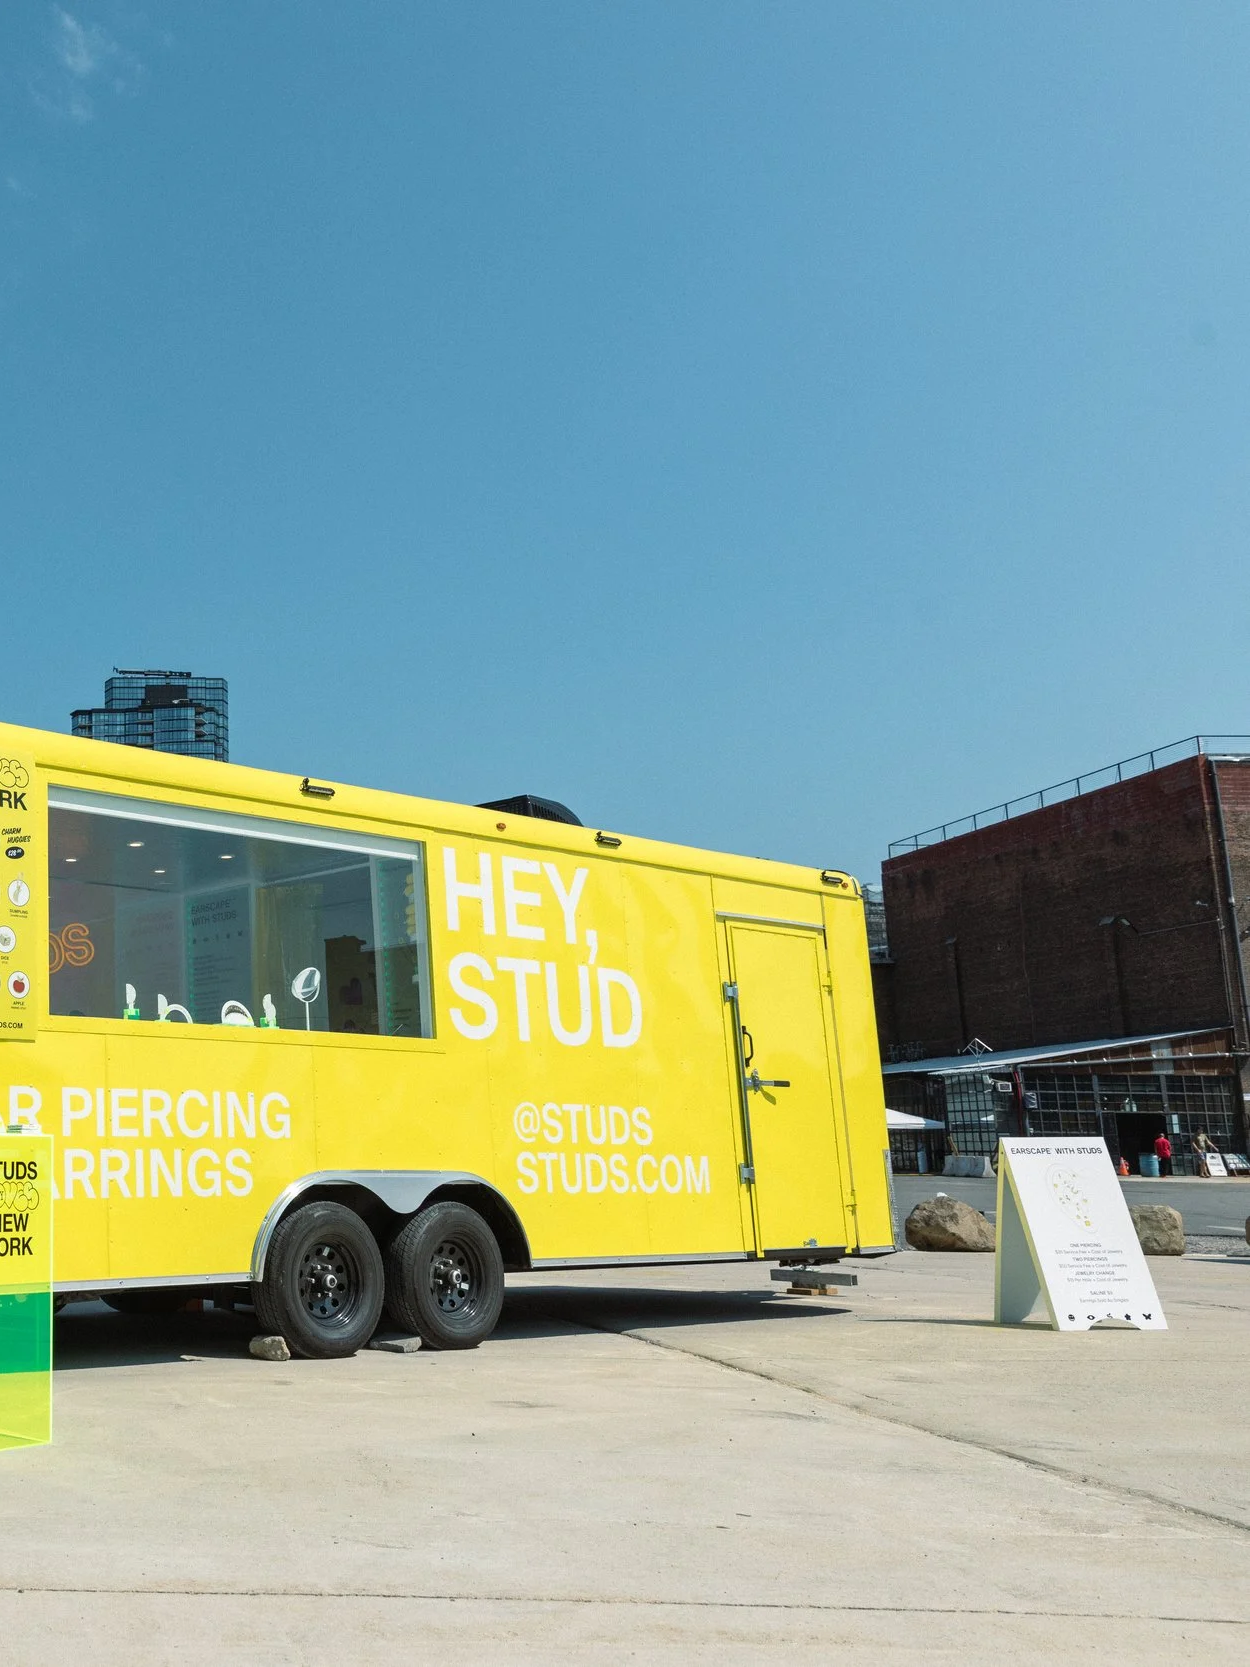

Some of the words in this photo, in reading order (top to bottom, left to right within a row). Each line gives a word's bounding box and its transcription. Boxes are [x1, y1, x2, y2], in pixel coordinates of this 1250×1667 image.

[2, 828, 22, 836] CHARM
[7, 836, 32, 844] HUGGIES
[442, 846, 599, 966] HEY,
[448, 952, 643, 1049] STUD
[62, 1087, 292, 1139] PIERCING
[513, 1102, 654, 1146] @STUDS
[1010, 1147, 1052, 1155] EARSCAPE
[1055, 1147, 1075, 1155] WITH
[1077, 1147, 1103, 1155] STUDS
[516, 1152, 711, 1195] STUDS.COM
